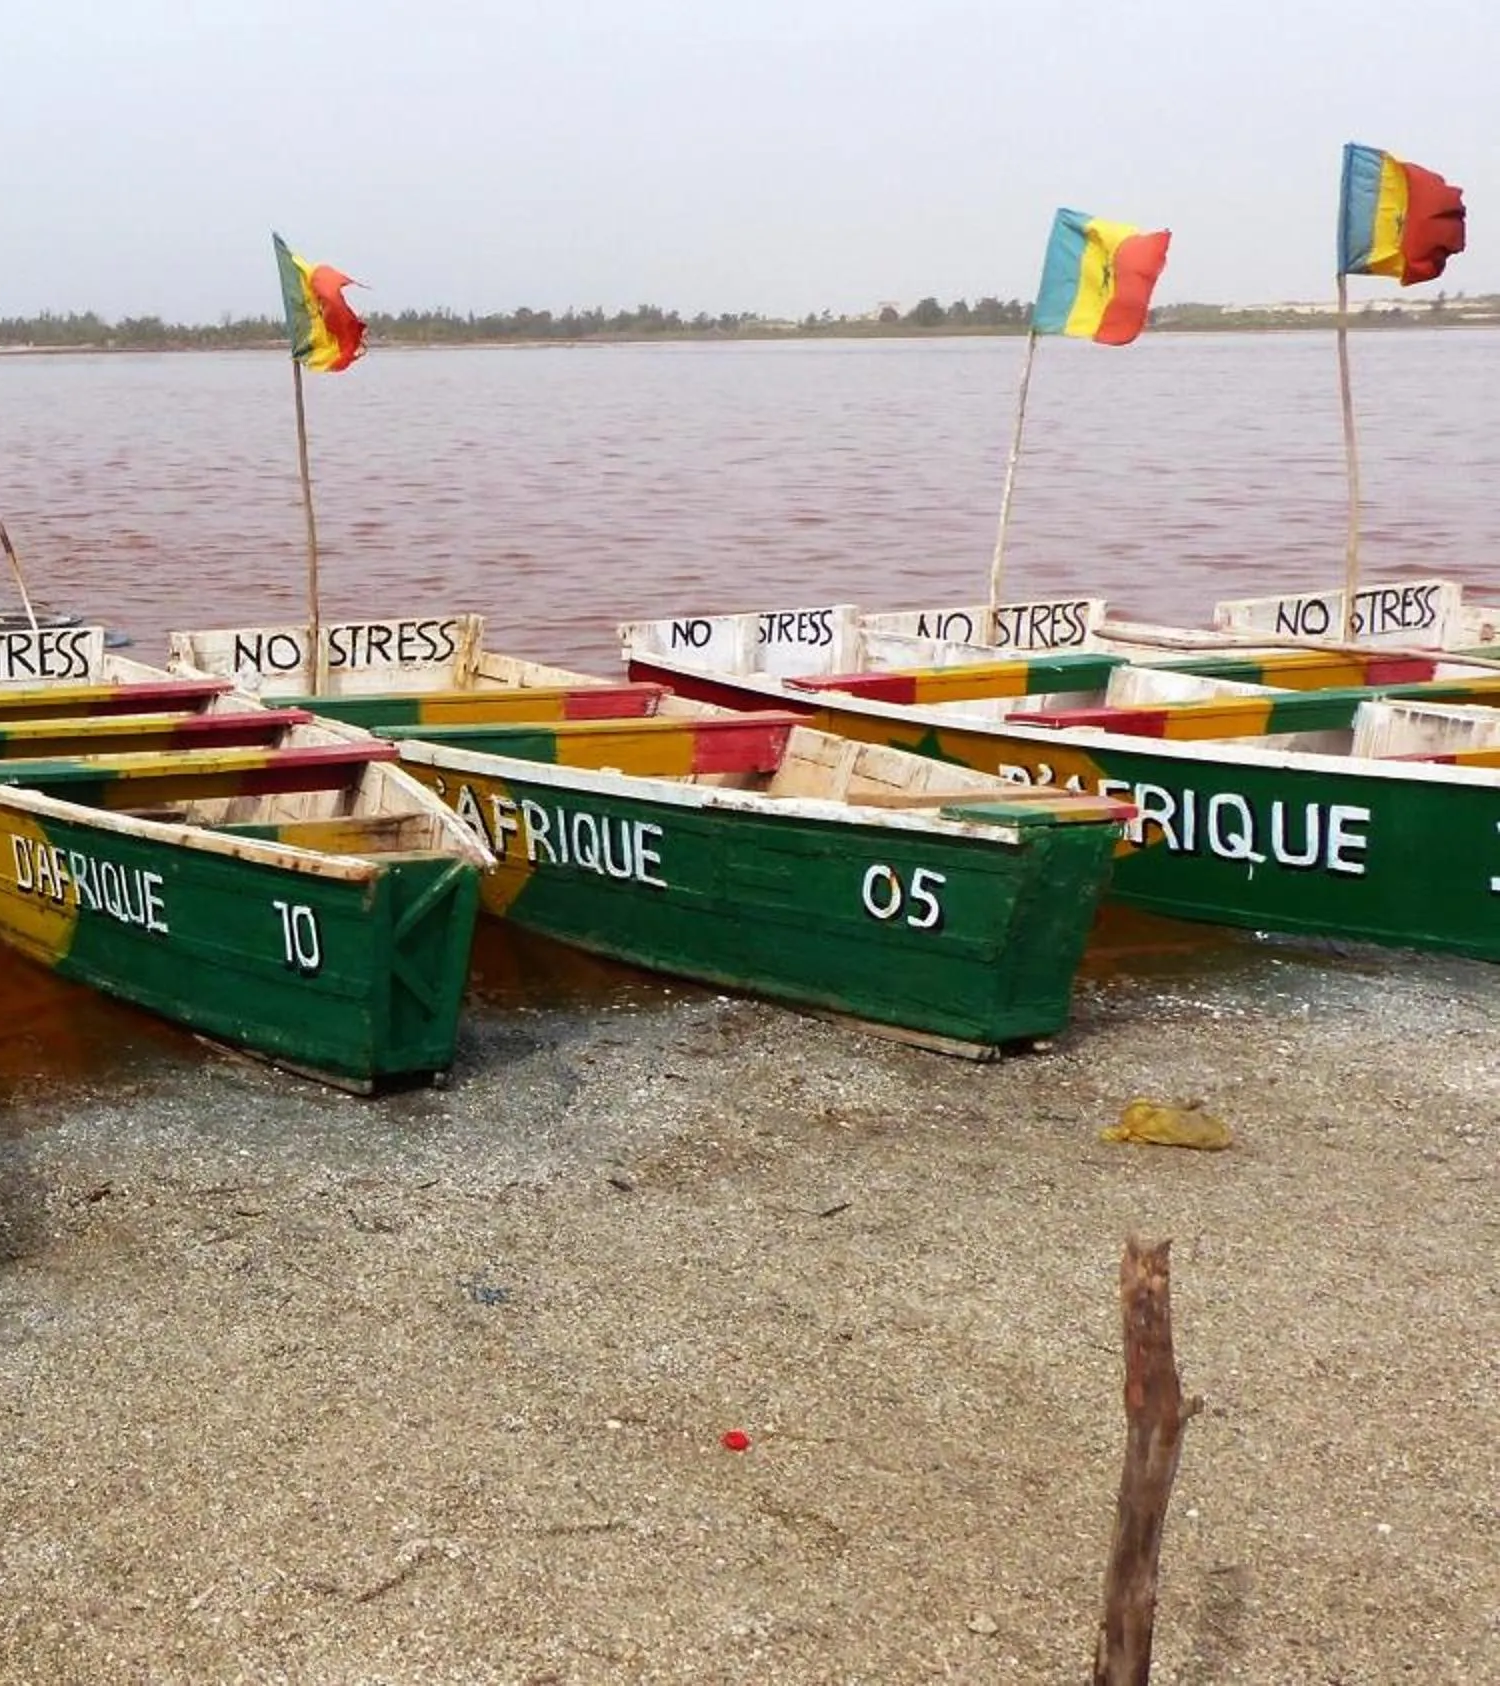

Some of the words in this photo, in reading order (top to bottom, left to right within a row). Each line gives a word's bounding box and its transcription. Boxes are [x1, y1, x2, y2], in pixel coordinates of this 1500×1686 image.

[671, 619, 713, 649] NO
[757, 609, 833, 647] STRESS
[995, 601, 1089, 649] STRESS
[1276, 598, 1330, 635] NO
[1350, 585, 1439, 634] STRESS
[234, 633, 301, 673] NO
[328, 620, 458, 669] STRESS
[11, 833, 170, 934] D'AFRIQUE
[272, 900, 321, 970] 10
[861, 863, 948, 930] 05
